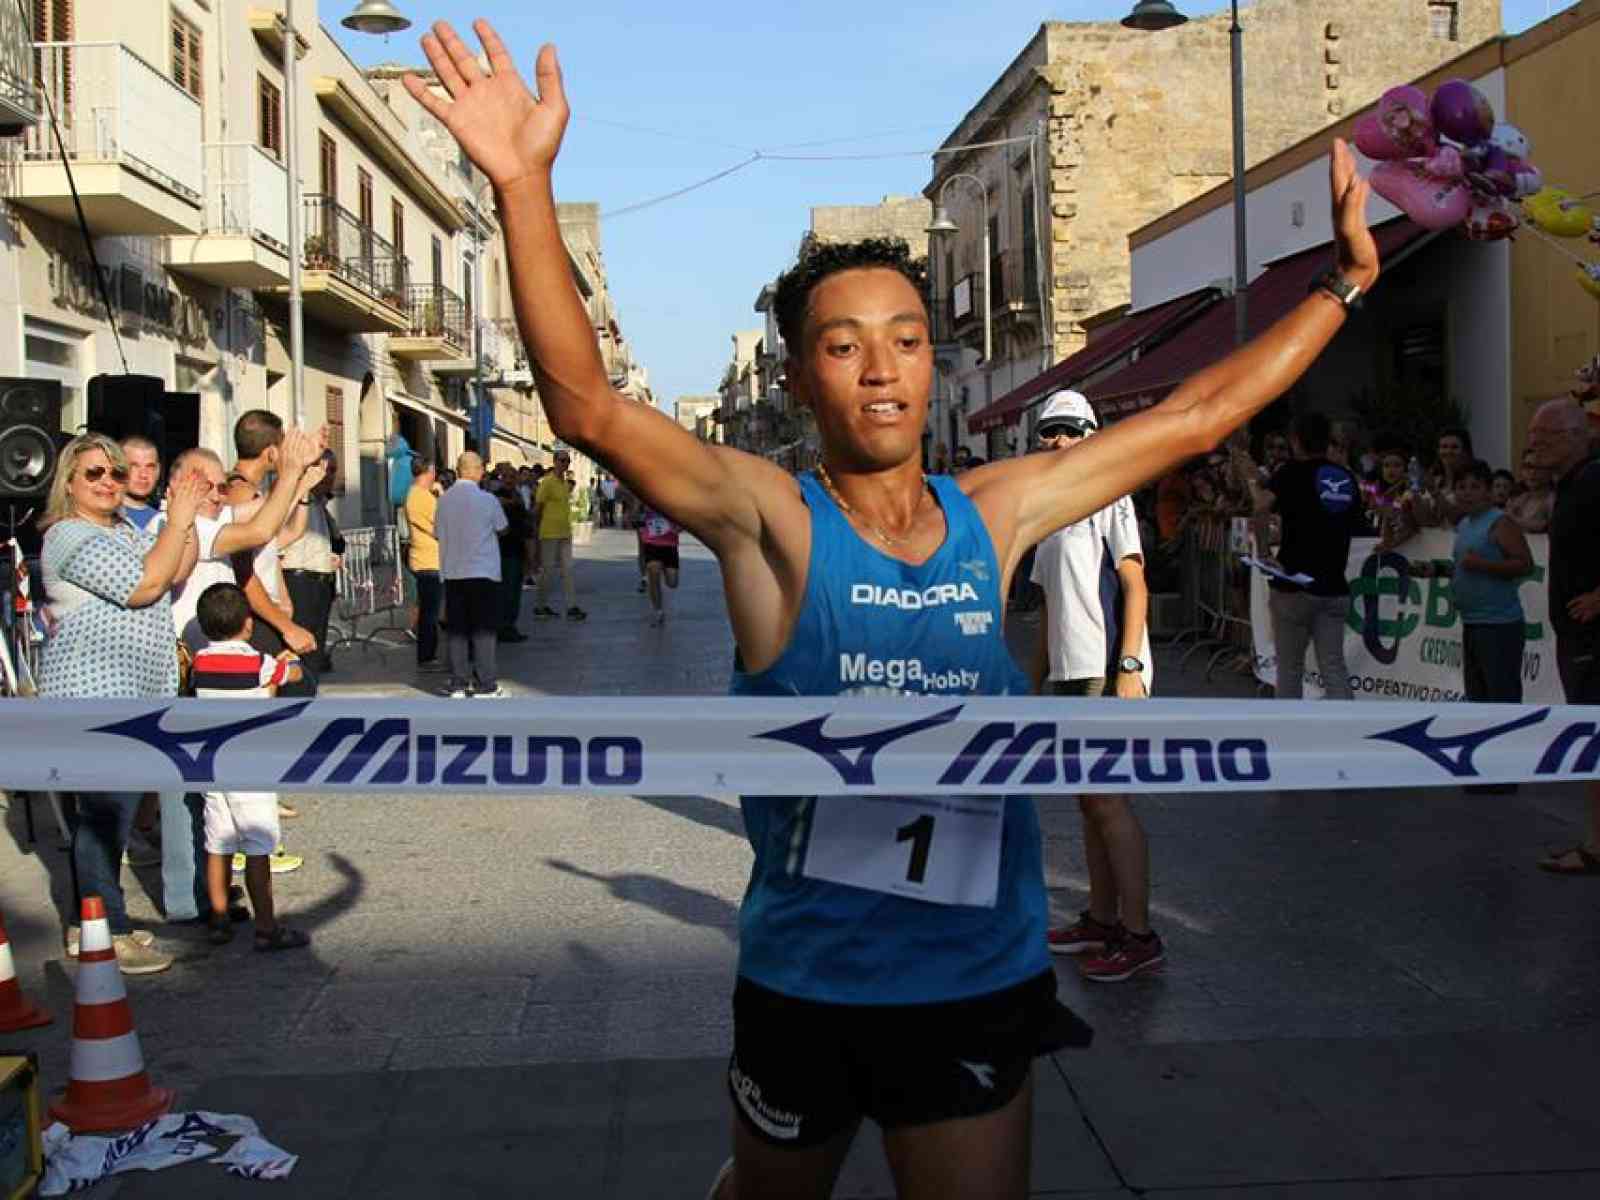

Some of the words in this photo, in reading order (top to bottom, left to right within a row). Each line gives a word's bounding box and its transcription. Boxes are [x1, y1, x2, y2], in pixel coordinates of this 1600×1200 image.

[851, 583, 978, 609] DIADORA
[840, 653, 922, 688] Mega
[279, 717, 643, 785] MIZUNO
[937, 722, 1270, 784] MIZUNO
[896, 814, 934, 882] 1
